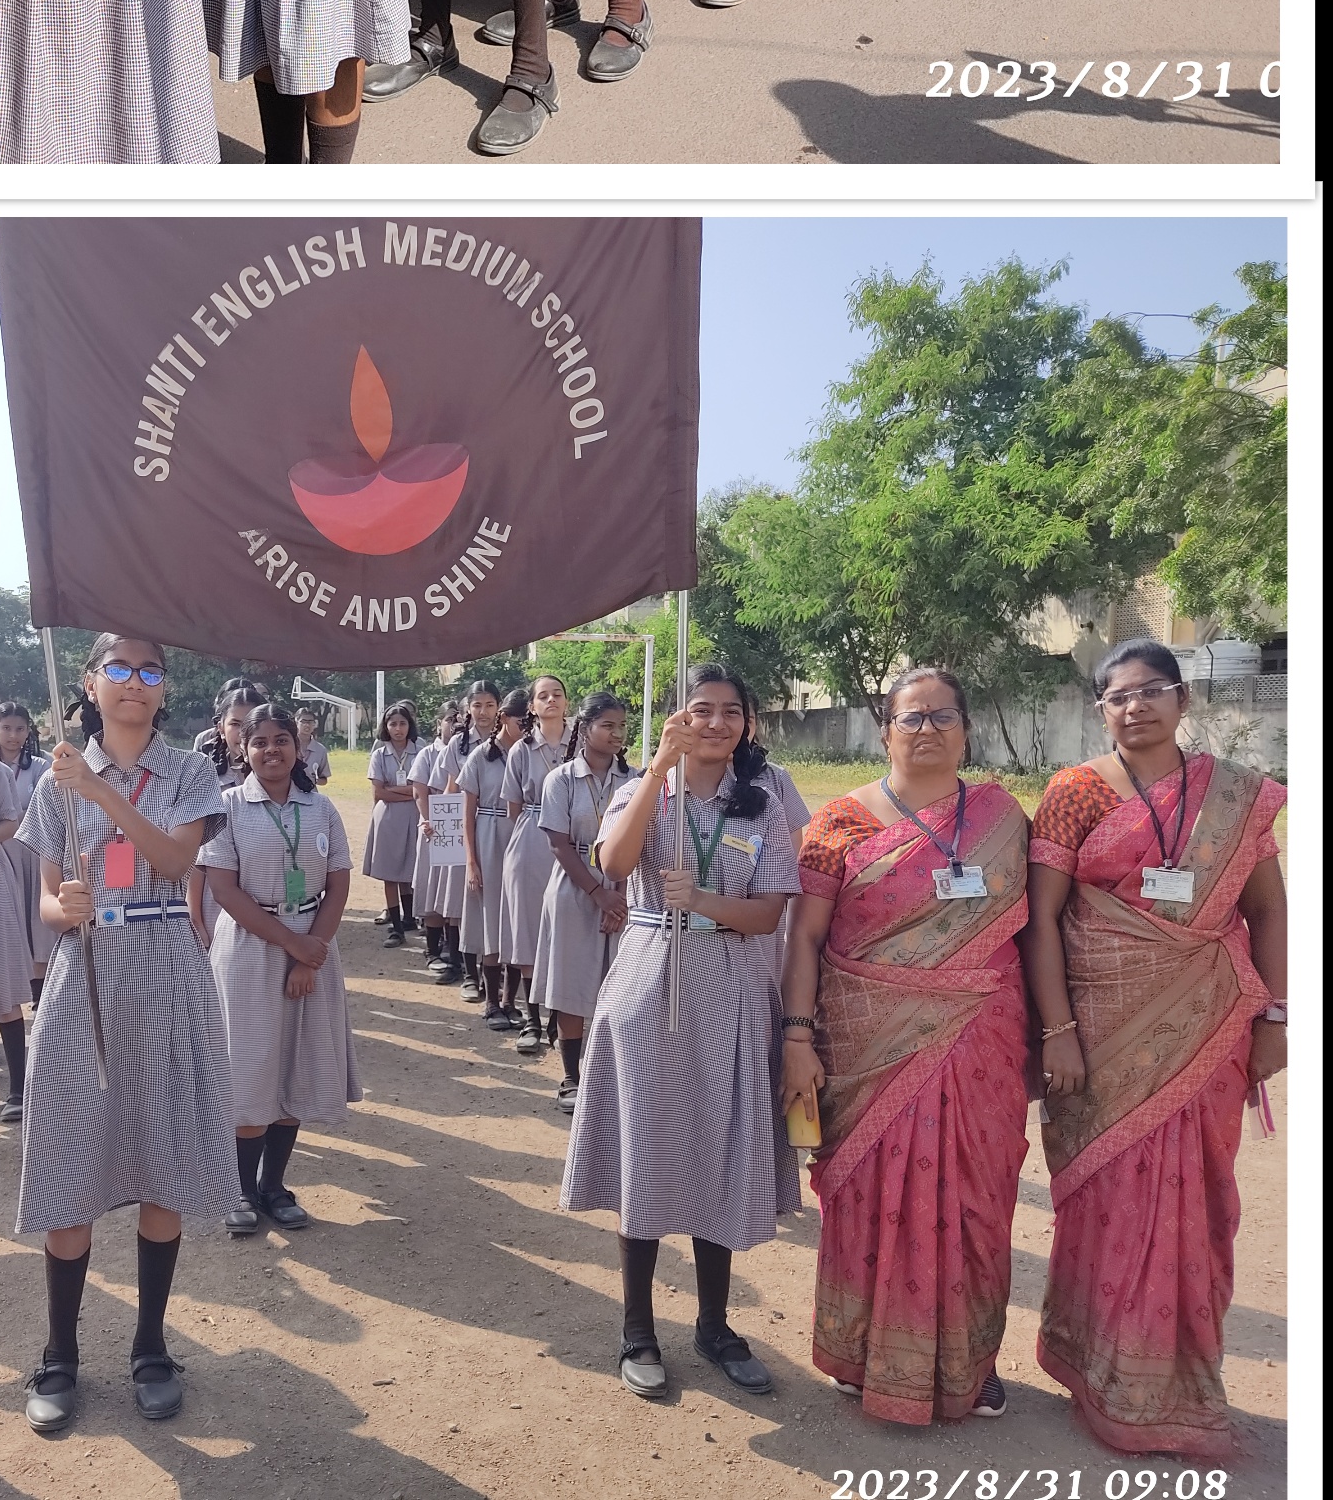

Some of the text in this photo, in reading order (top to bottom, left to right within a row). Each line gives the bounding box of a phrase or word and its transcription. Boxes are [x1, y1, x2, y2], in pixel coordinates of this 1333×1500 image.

[133, 220, 608, 482] SHANTI ENGLISH MEDIUM SCHOOL
[237, 516, 512, 633] ARISE AND SHINE
